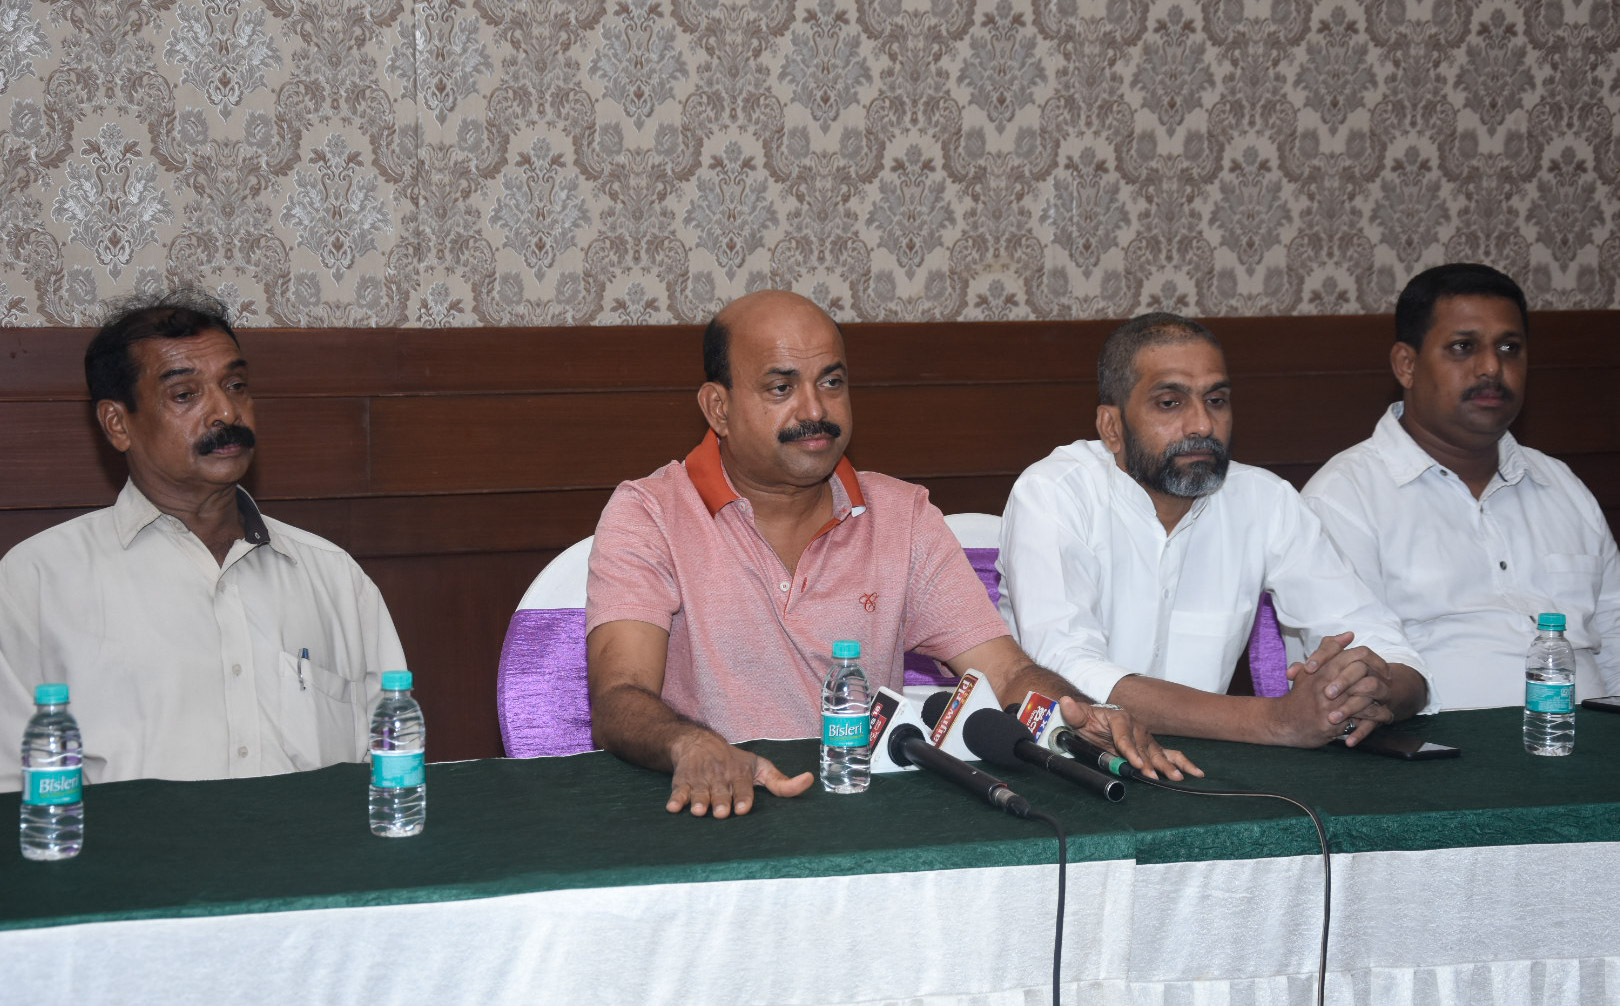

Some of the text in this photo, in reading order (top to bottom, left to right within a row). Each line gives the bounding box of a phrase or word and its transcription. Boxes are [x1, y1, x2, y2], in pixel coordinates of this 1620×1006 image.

[930, 679, 971, 745] aijiworld
[828, 721, 863, 737] Bisleri
[39, 774, 80, 793] Bisleri
